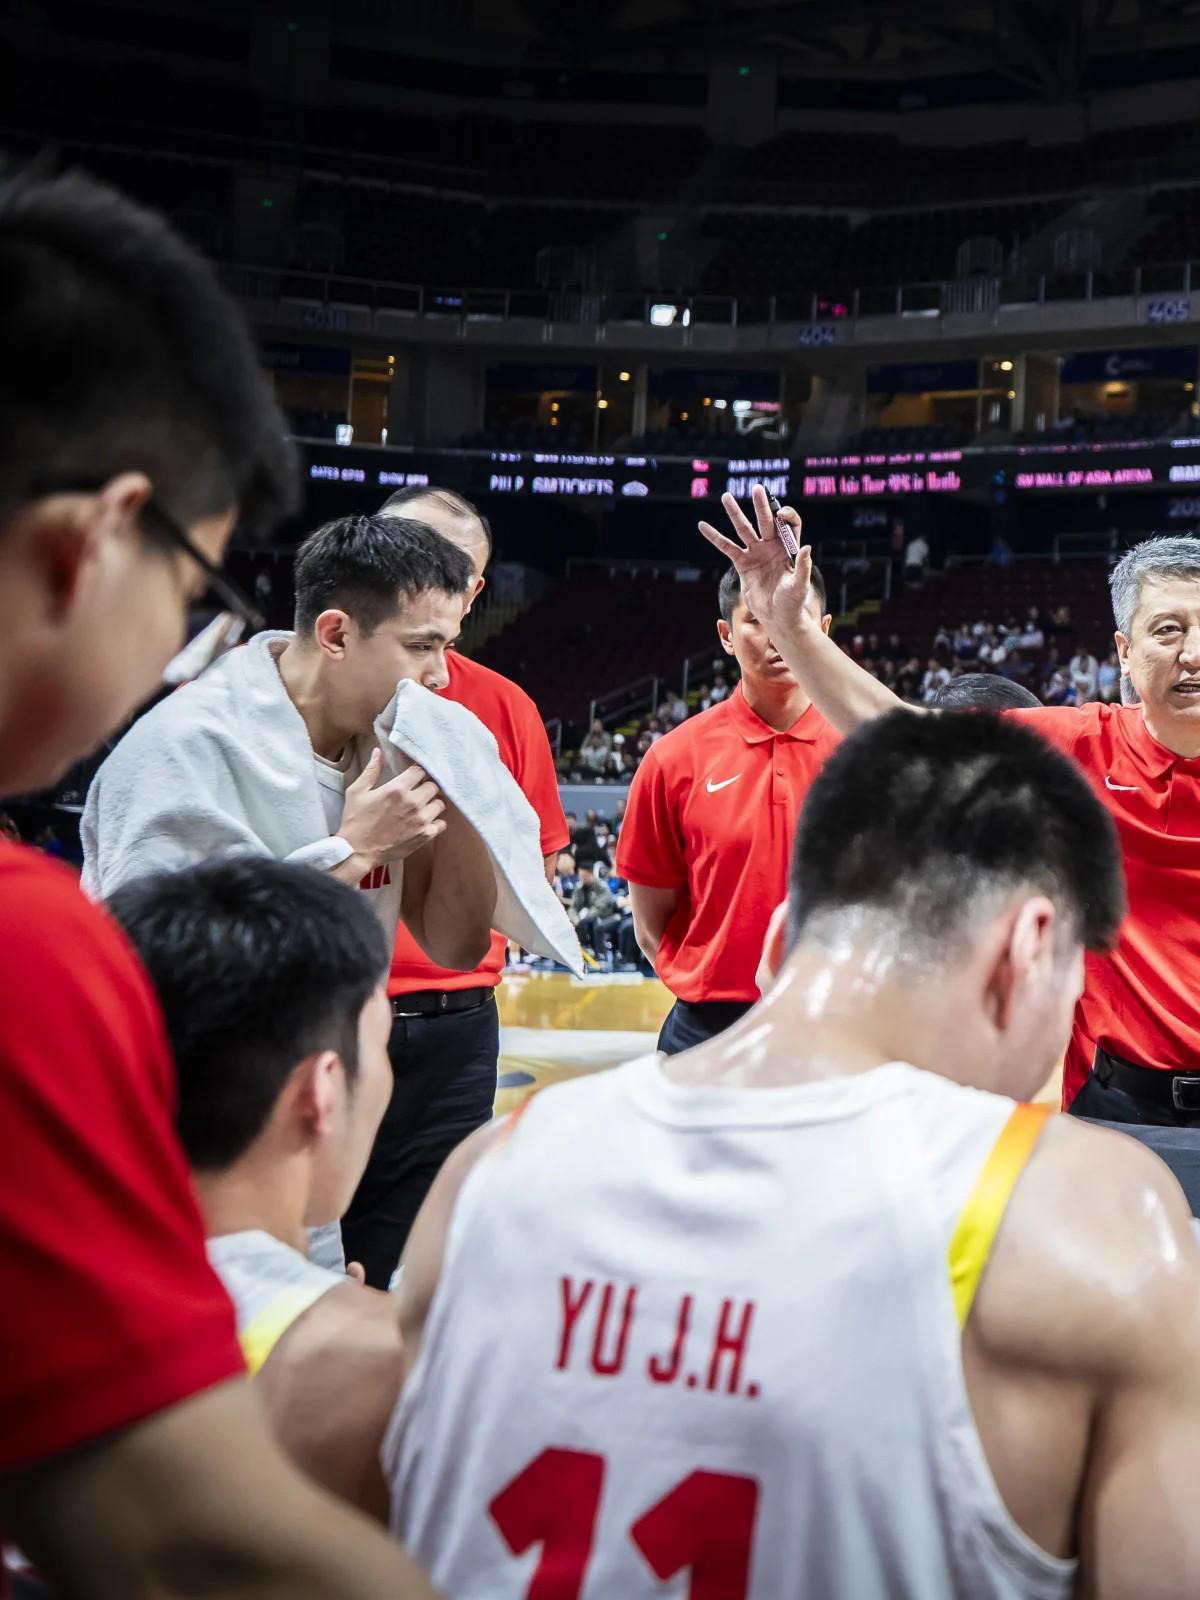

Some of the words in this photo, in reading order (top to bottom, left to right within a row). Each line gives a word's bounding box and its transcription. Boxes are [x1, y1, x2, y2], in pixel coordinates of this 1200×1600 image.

[1150, 301, 1189, 321] 405
[1035, 472, 1064, 488] MALL
[1066, 471, 1084, 487] OF
[1086, 469, 1112, 485] ASIA
[1113, 468, 1152, 484] ARENA
[553, 1275, 638, 1377] YU
[647, 1293, 762, 1400] J.H.
